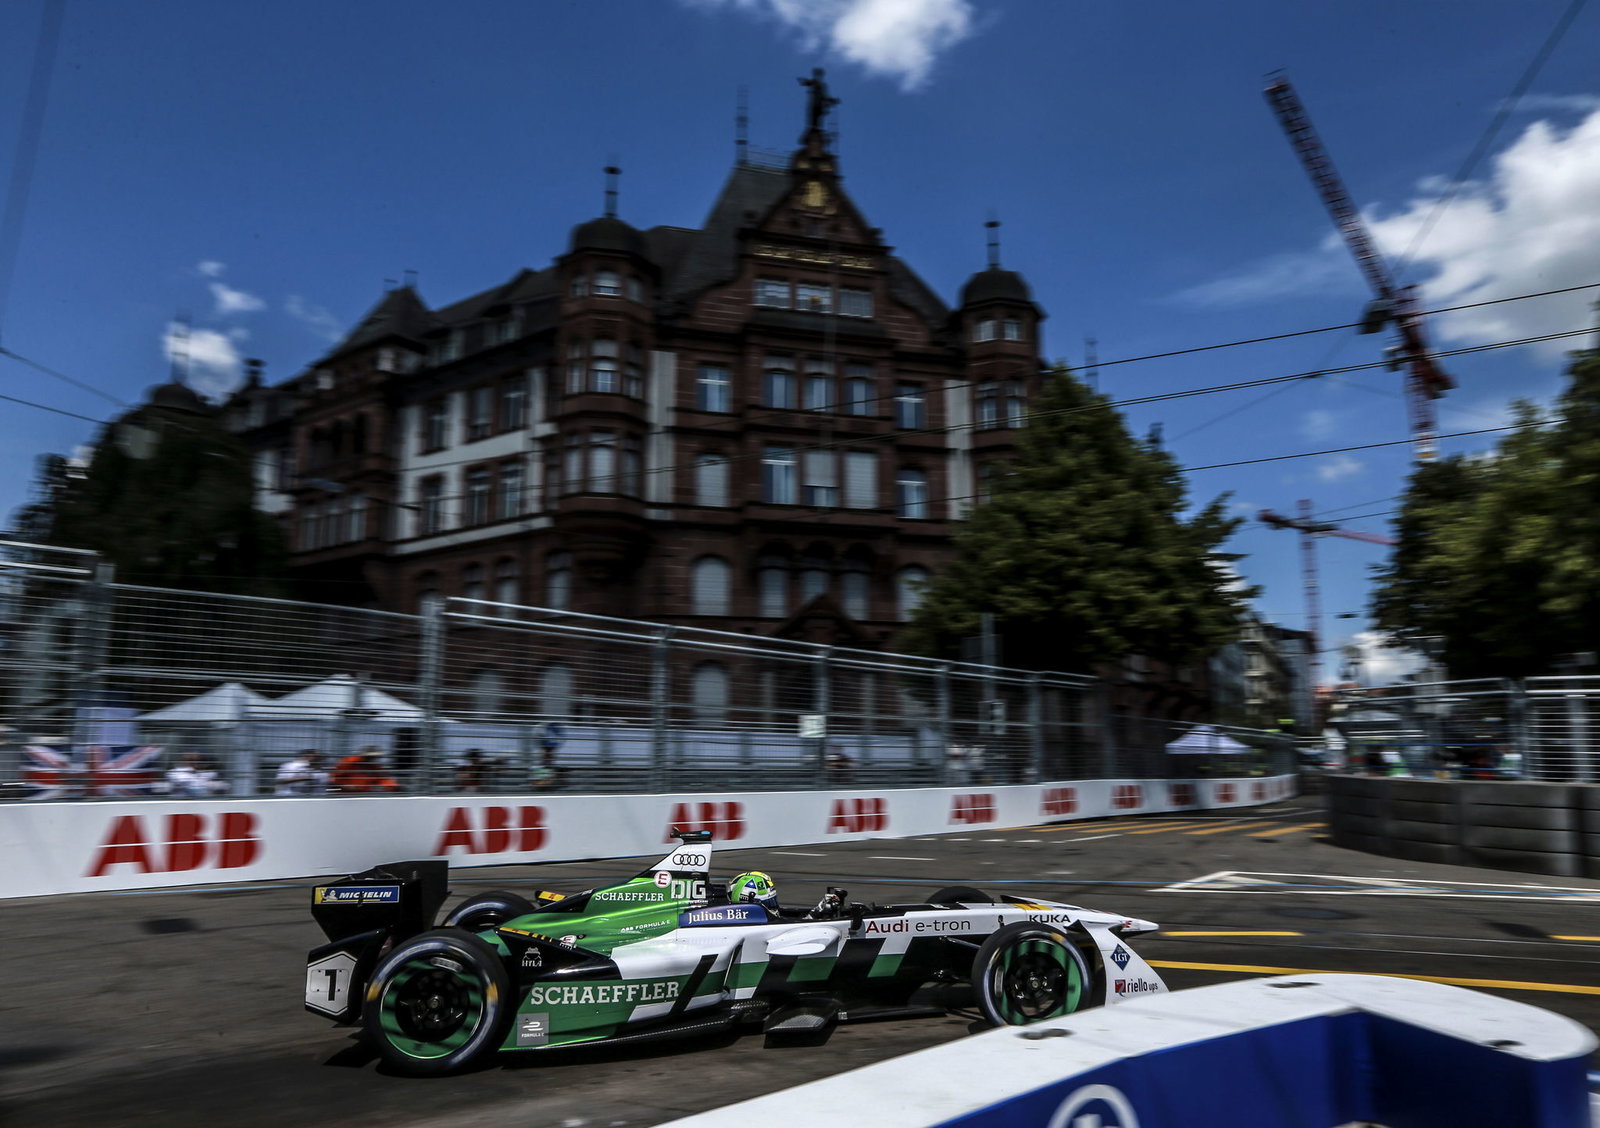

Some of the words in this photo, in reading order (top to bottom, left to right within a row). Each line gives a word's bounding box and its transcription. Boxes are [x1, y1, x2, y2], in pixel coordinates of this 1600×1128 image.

[663, 802, 747, 844] ABB
[827, 798, 890, 834] ABB
[433, 806, 551, 856] ABB
[82, 812, 265, 877] ABB
[595, 892, 665, 901] SCHAEFFLER
[688, 912, 723, 924] Julius
[727, 909, 748, 920] Bär
[866, 920, 909, 933] Audi
[915, 919, 971, 932] e-tron
[1029, 914, 1071, 924] KUKA
[1114, 953, 1128, 962] LGT
[325, 969, 337, 1001] 1
[531, 981, 679, 1005] SCHAEFFLER
[1127, 979, 1148, 993] riello
[1149, 982, 1158, 993] ups
